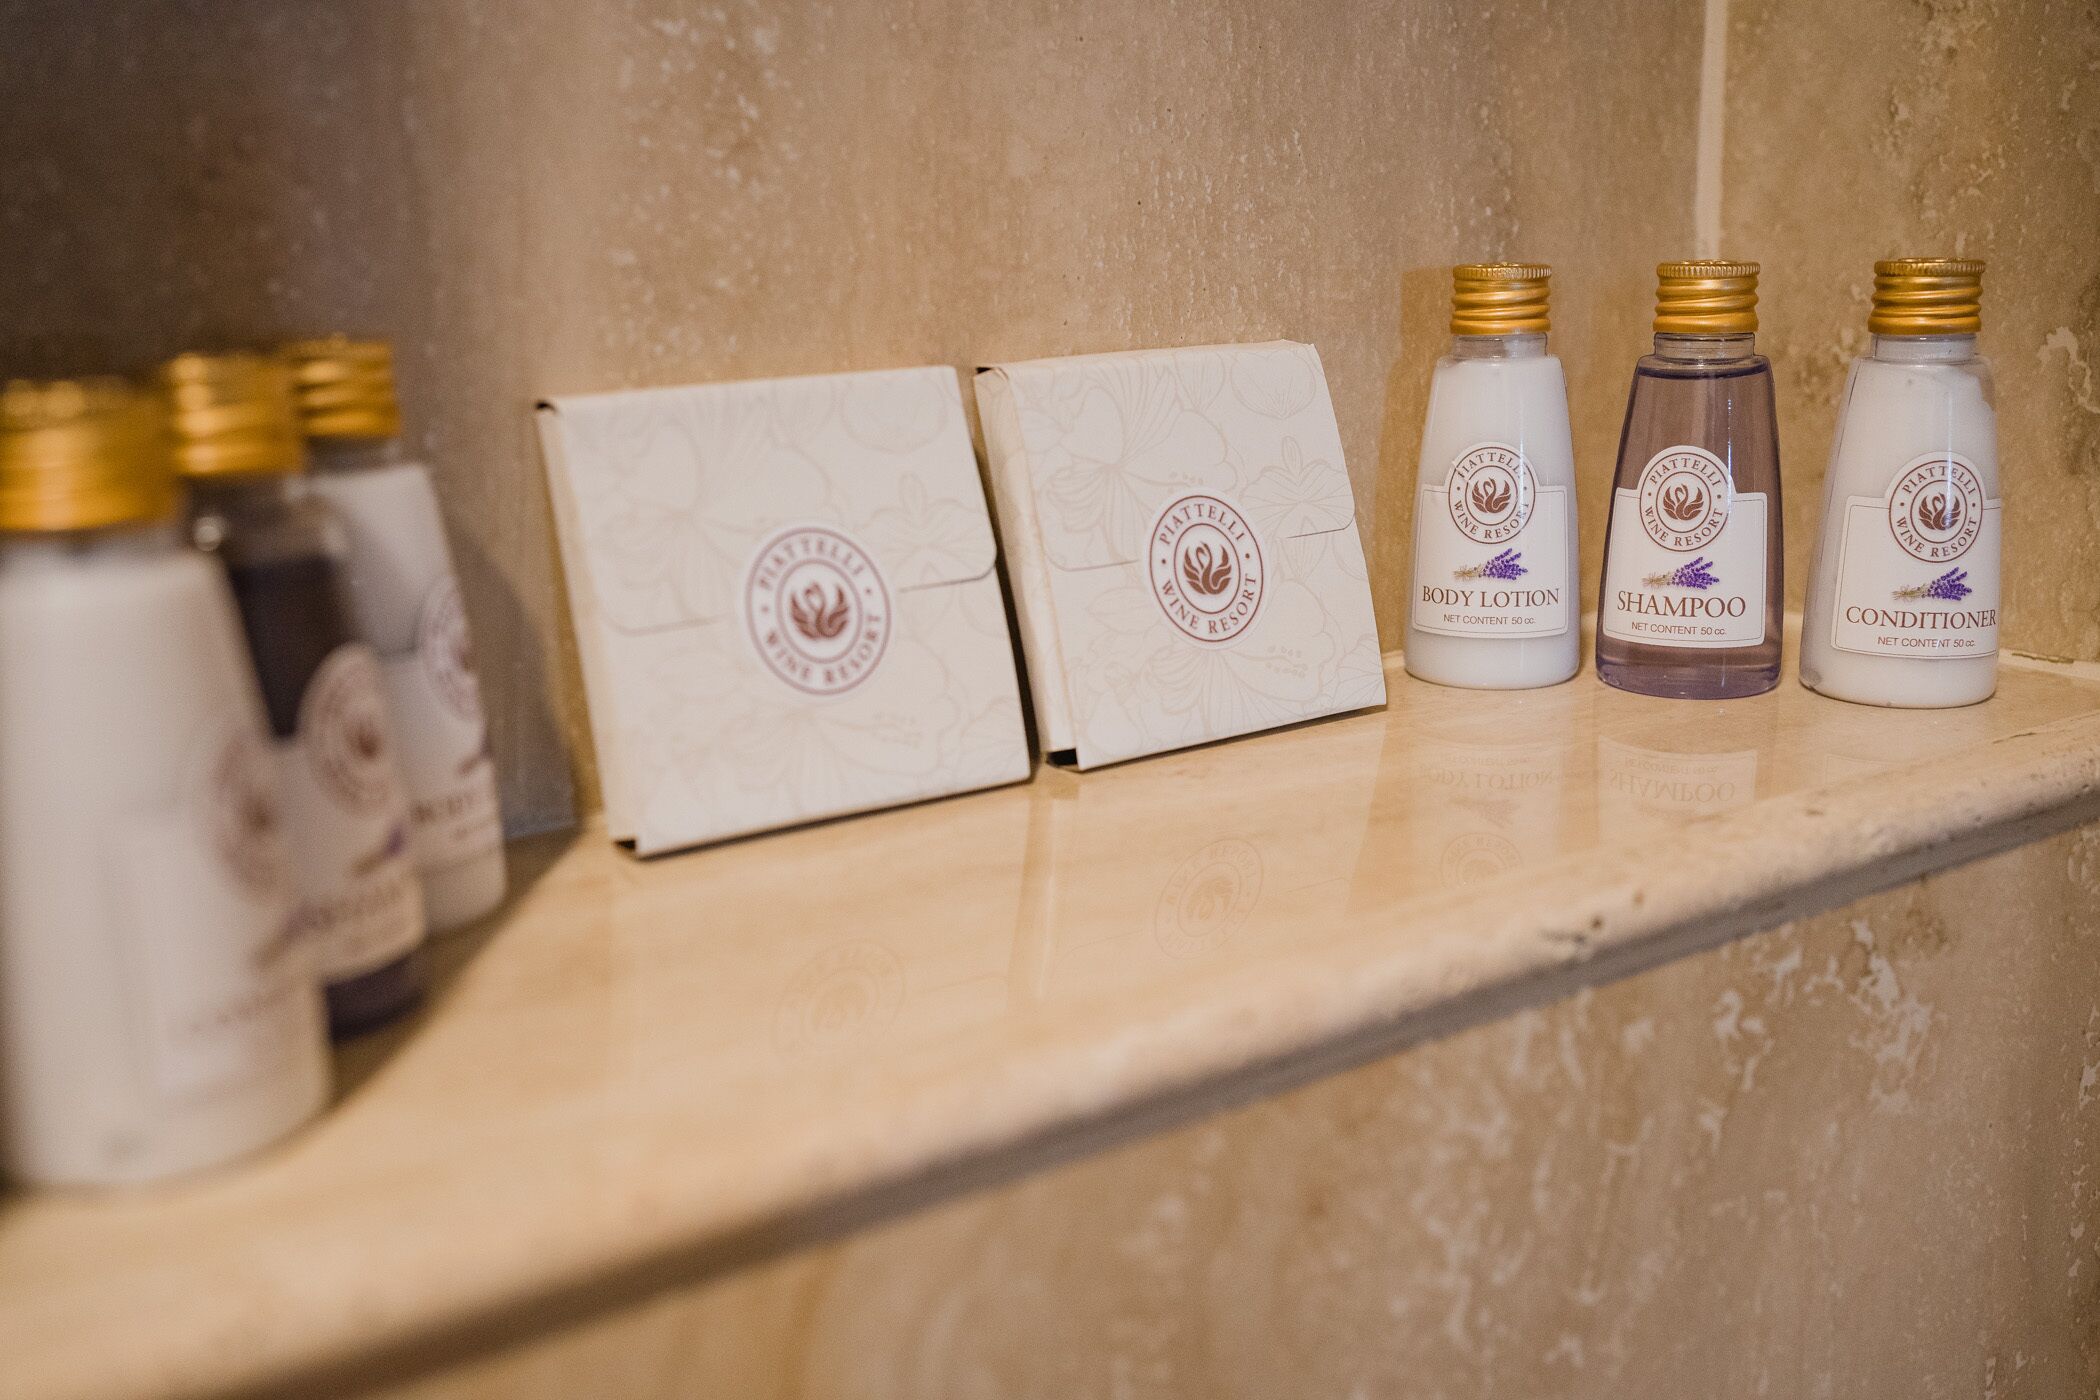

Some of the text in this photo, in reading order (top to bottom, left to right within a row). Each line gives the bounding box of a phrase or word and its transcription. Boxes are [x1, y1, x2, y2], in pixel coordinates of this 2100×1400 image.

[1457, 452, 1526, 479] IATTELL
[1651, 457, 1722, 487] PIATTELLI
[1902, 465, 1976, 495] PIATTELLI
[1159, 503, 1246, 545] PIATTELLI
[1454, 500, 1479, 535] WINE
[1644, 506, 1724, 547] WINE RESORT
[1896, 516, 1977, 557] WINE RESORT
[1162, 574, 1257, 634] WINE RESORT
[1422, 585, 1560, 608] BODY LOTION
[1617, 590, 1746, 618] SHAMPOO
[1443, 613, 1460, 623] NET
[1462, 615, 1508, 625] CONTENT
[1511, 616, 1523, 625] 50
[1631, 621, 1648, 631] NET
[1650, 623, 1697, 635] CONTENT
[1700, 626, 1713, 635] 50
[1846, 606, 1996, 630] CONDITIONER
[1877, 636, 1899, 646] NET
[1901, 637, 1951, 648] CONTENT
[1953, 639, 1964, 648] 50
